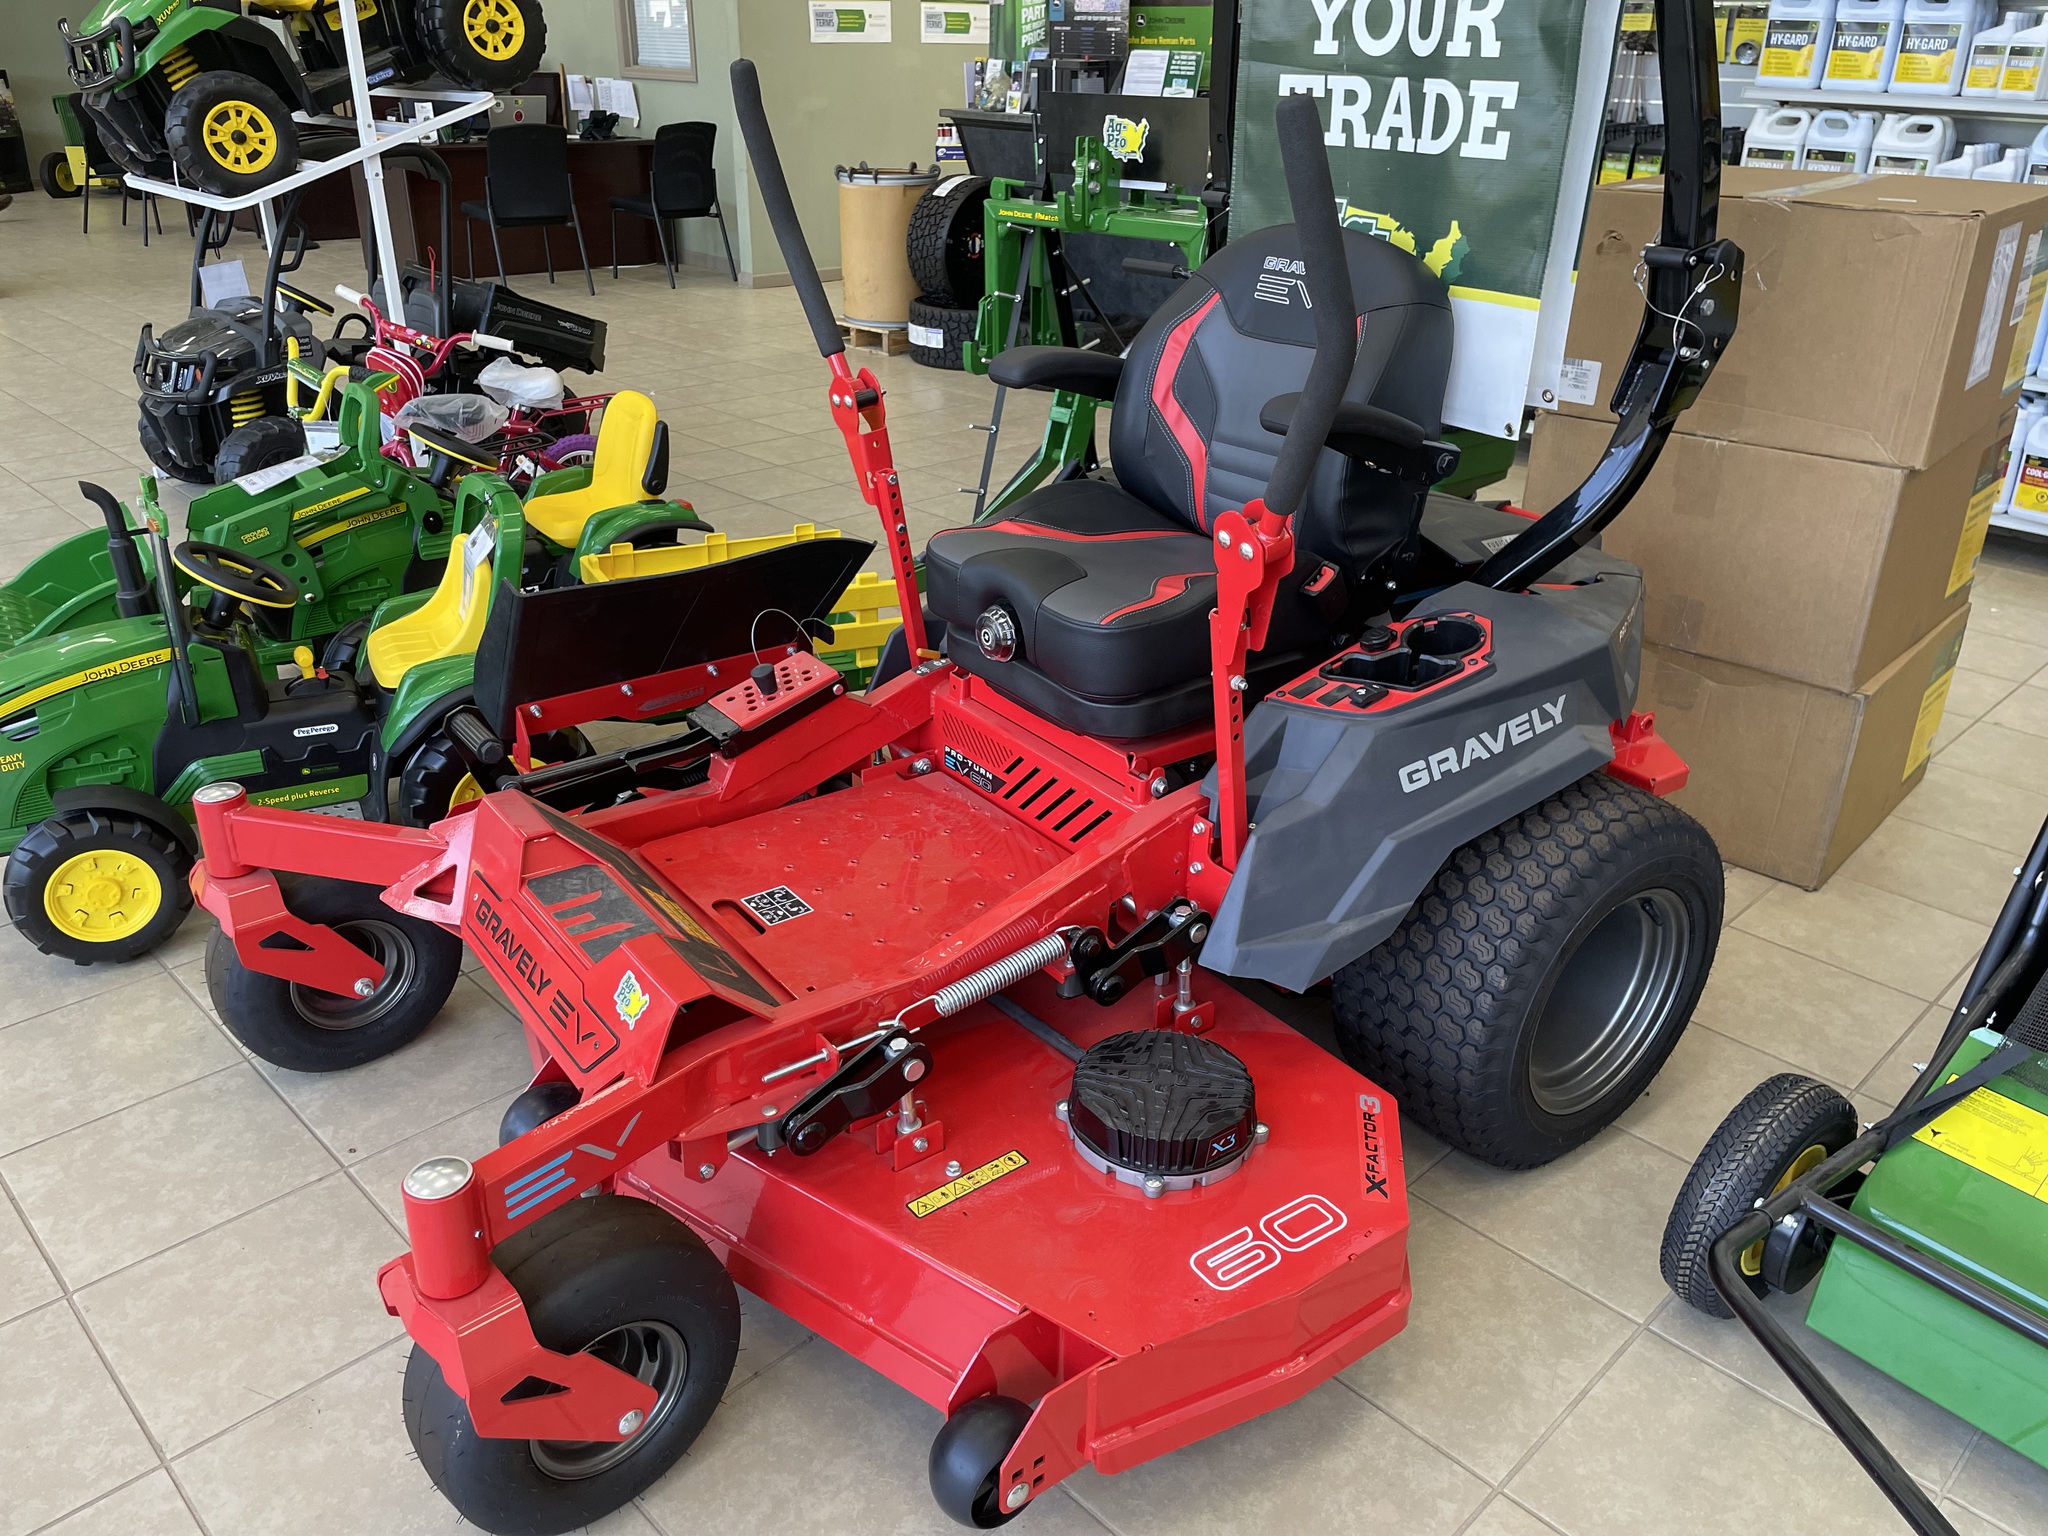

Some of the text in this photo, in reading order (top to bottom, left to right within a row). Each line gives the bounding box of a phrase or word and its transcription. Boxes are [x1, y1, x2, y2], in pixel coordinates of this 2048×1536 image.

[1021, 4, 1046, 24] PART
[1021, 28, 1046, 48] PRICE
[1311, 0, 1505, 58] YOUR
[1770, 32, 1809, 46] HY-GARD
[1179, 36, 1196, 46] Parts
[1837, 34, 1878, 48] HY-GARD
[1905, 37, 1949, 51] HY-GARD
[1107, 118, 1127, 136] Ag-
[1106, 134, 1127, 148] Pro
[297, 498, 342, 519] JOHN DEERE
[347, 506, 402, 528] JOHN DEERE
[243, 531, 271, 545] LOADER
[82, 654, 163, 683] JOHN DEERE
[1398, 694, 1567, 794] GRAVELY
[1, 761, 26, 773] DUTY
[944, 745, 993, 780] PRO-TURN
[257, 786, 340, 806] 2-Speed plus Reverse
[473, 898, 597, 1045] GRAVELY EV
[622, 975, 636, 994] Ag-
[616, 986, 631, 1007] Pro
[1211, 1133, 1236, 1157] X3
[504, 1110, 643, 1220] EV
[1189, 1194, 1348, 1291] 60
